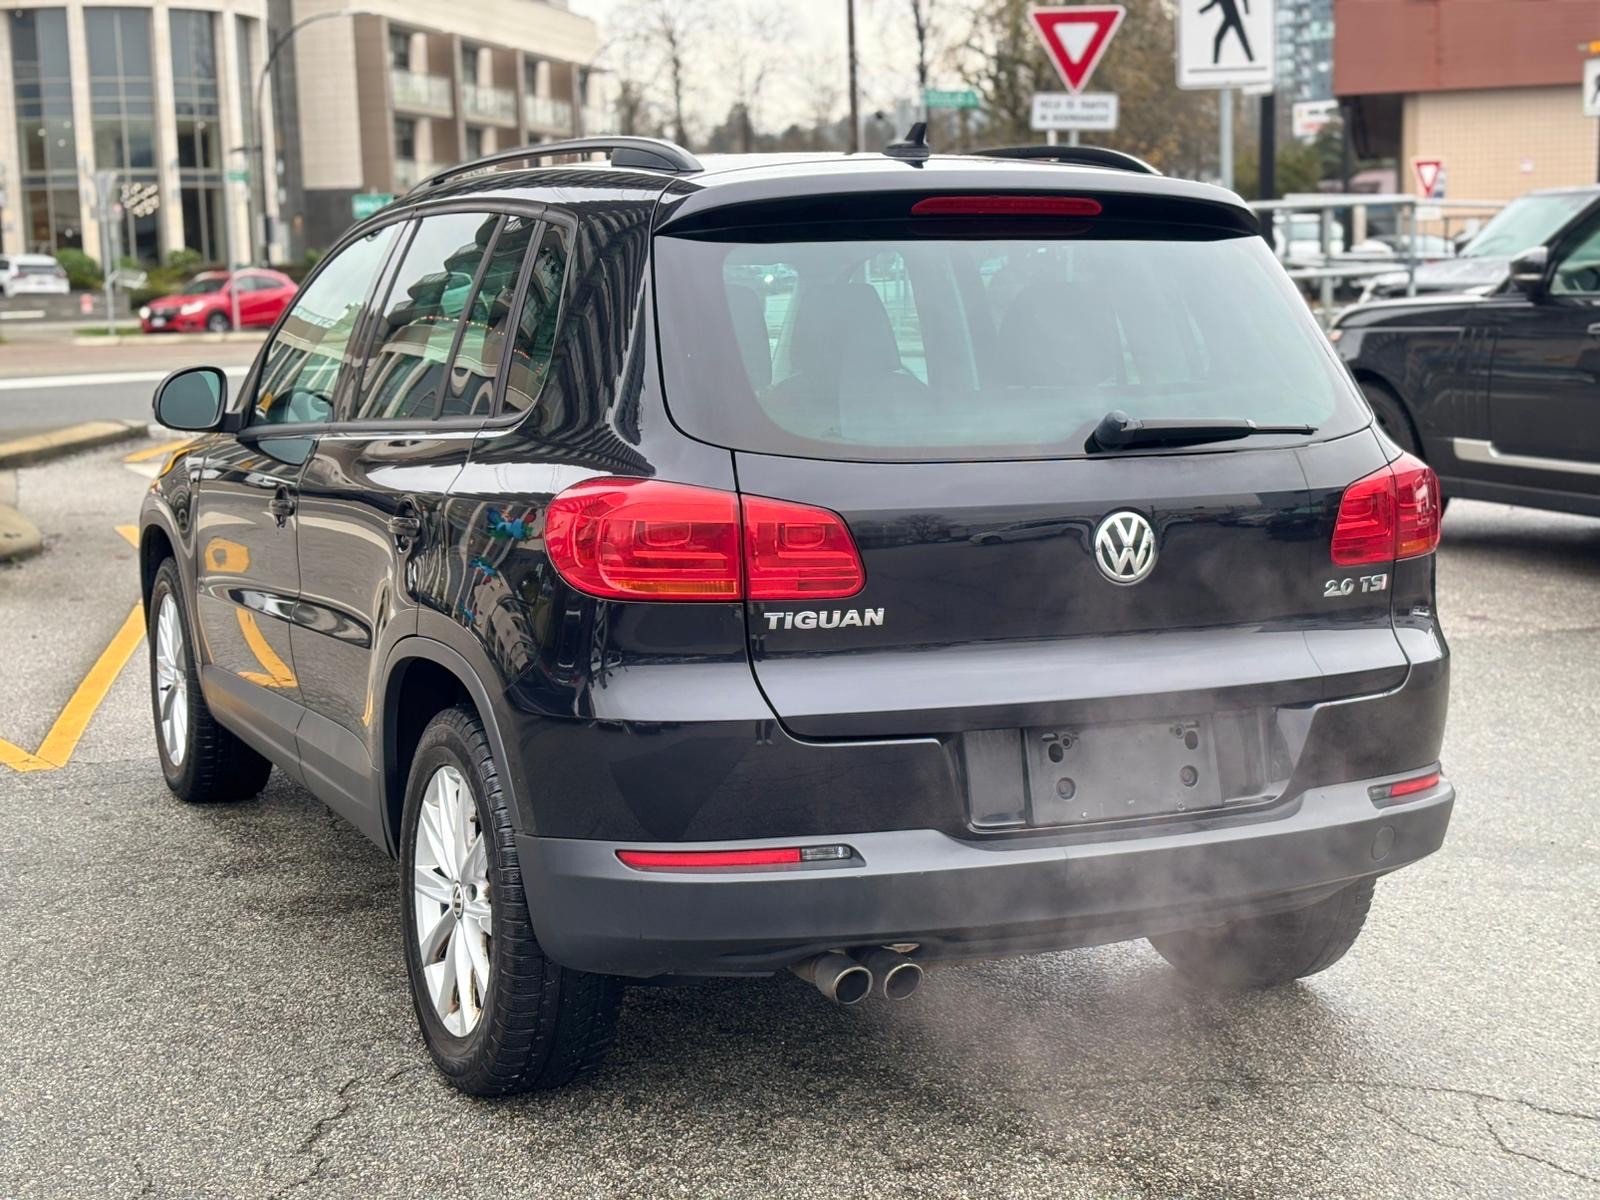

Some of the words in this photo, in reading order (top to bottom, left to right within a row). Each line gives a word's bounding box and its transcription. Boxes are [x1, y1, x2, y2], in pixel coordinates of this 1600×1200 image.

[1094, 510, 1156, 585] VW
[1359, 573, 1388, 593] TSI
[763, 607, 885, 630] TIGUAN
